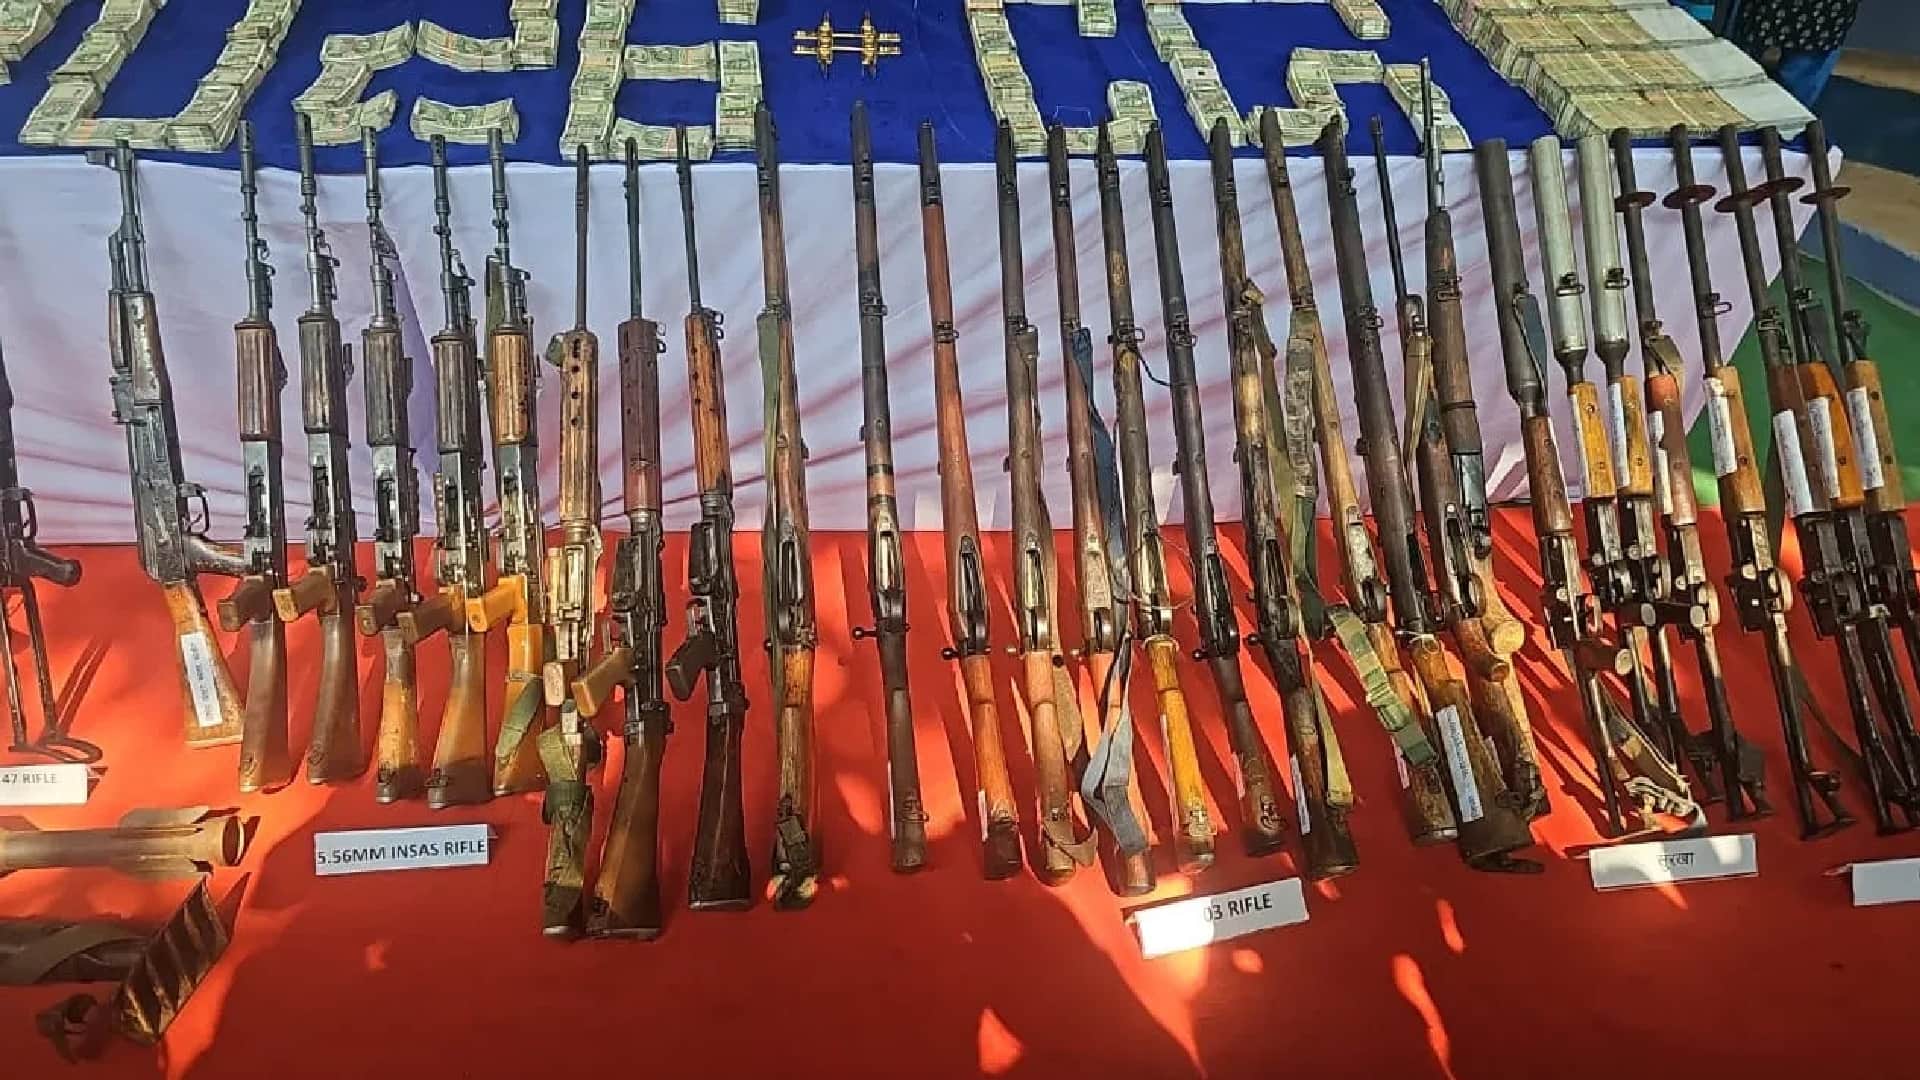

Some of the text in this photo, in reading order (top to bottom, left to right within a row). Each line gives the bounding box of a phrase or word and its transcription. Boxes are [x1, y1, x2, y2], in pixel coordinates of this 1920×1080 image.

[22, 773, 57, 784] RIFLE
[317, 839, 486, 864] 5.56MM INSAS RIFLE
[1228, 893, 1273, 917] RIFLE
